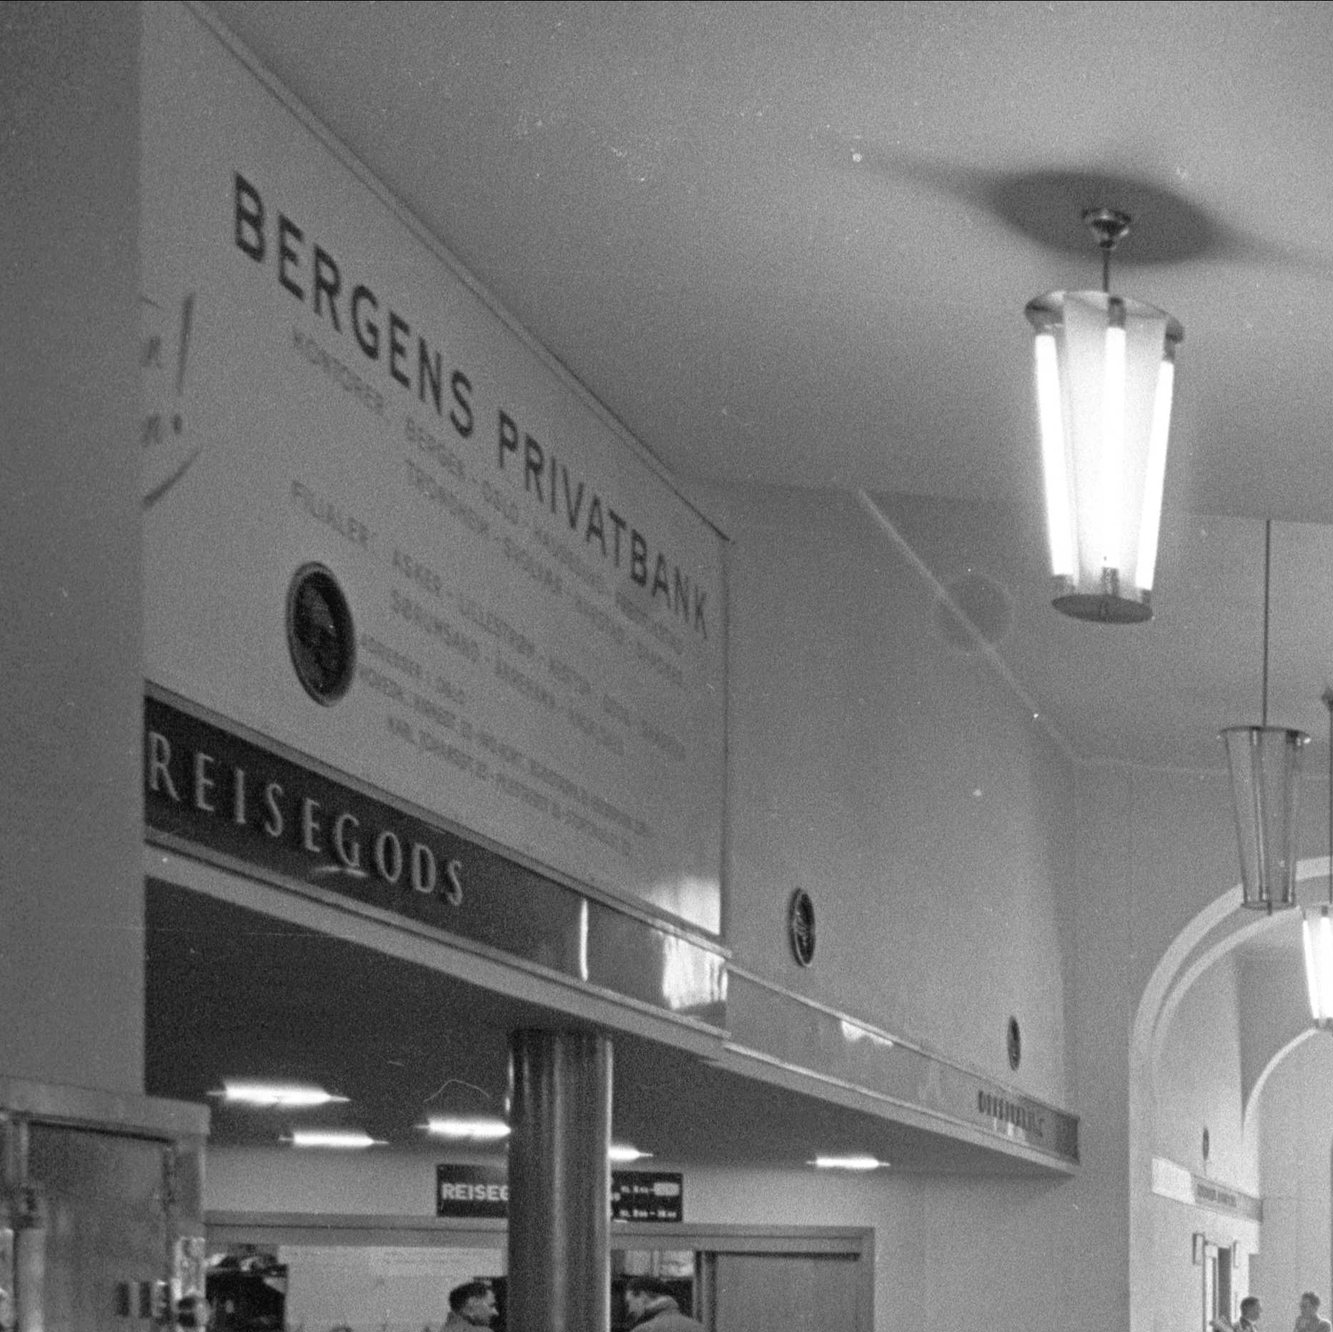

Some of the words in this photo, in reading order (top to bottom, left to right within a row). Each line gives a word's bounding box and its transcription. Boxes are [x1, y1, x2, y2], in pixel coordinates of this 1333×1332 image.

[234, 171, 474, 438] BERGENS
[499, 410, 708, 639] PRIVATBANK
[148, 730, 464, 905] REISEGODS
